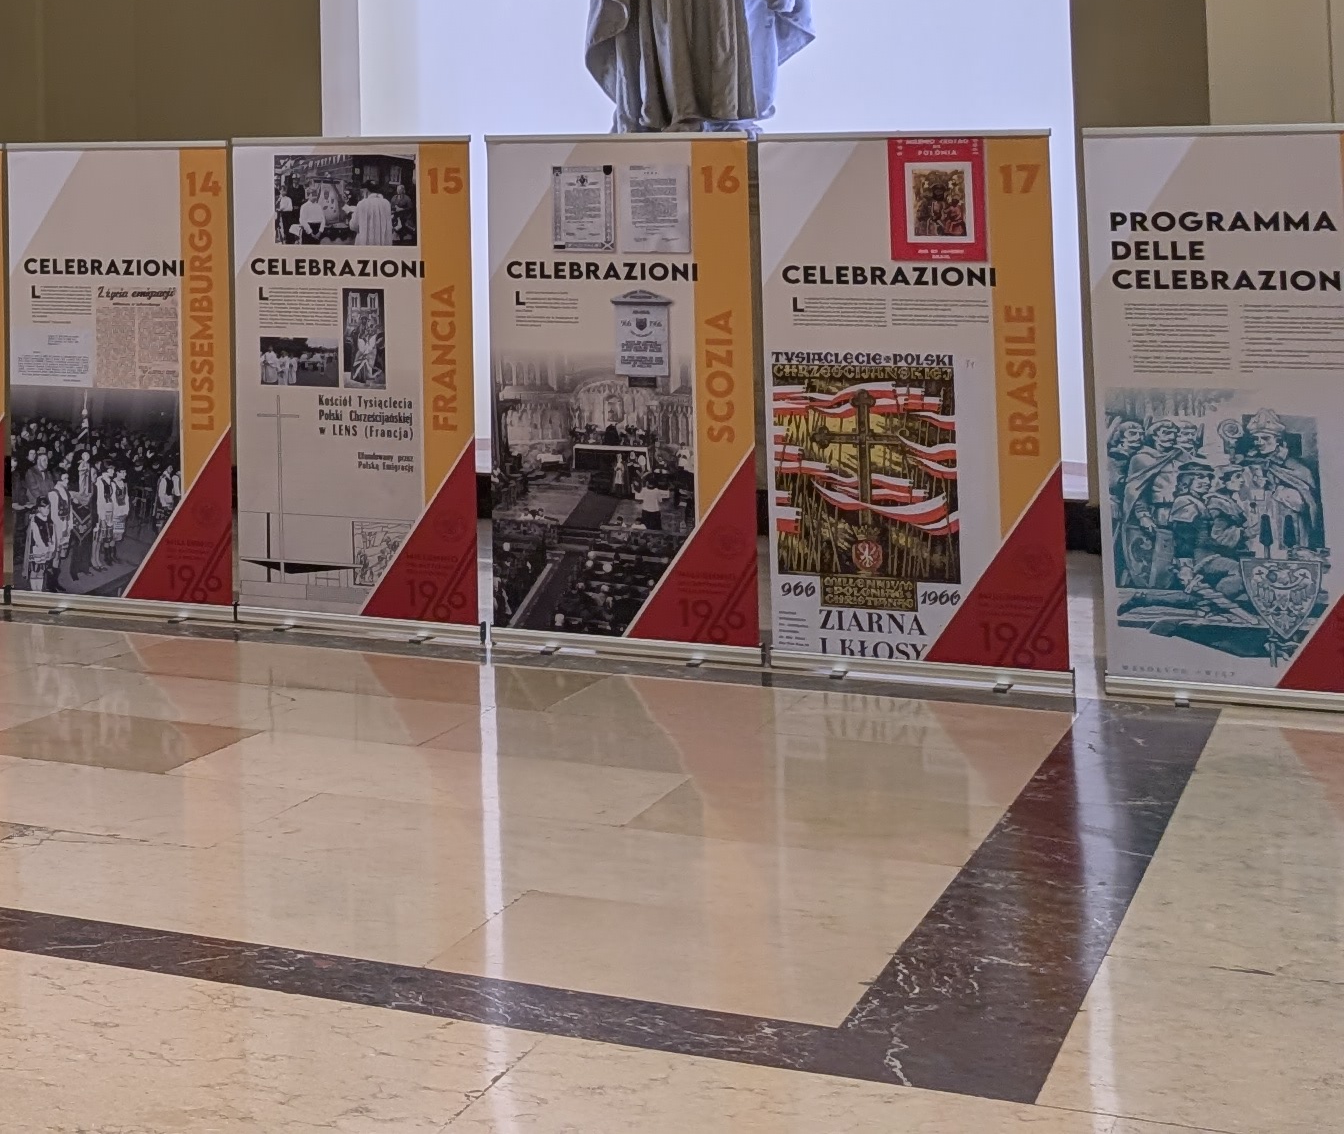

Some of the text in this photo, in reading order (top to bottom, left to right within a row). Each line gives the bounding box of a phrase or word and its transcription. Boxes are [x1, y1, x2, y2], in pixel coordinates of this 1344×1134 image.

[187, 171, 221, 197] 14
[428, 168, 462, 194] 15
[701, 166, 740, 194] 16
[1000, 164, 1039, 194] 17
[1110, 211, 1338, 231] PROGRAMMA
[1111, 241, 1205, 260] DELLE
[24, 258, 184, 277] CELEBRAZIONI
[251, 258, 425, 278] CELEBRAZIONI
[507, 261, 698, 281] CELEBRAZIONI
[782, 265, 997, 286] CELEBRAZIONI
[1112, 269, 1342, 291] CELEBRAZION
[32, 285, 41, 298] L
[259, 287, 269, 300] L
[515, 291, 526, 305] L
[792, 297, 805, 312] L
[188, 203, 214, 431] LUSSEMBURGO
[431, 285, 457, 431] FRANCIA
[892, 353, 954, 366] POLSKI
[704, 310, 735, 443] SCOZIA
[1004, 305, 1040, 457] BRASILE
[318, 395, 413, 409] Kościół Tysiąclecia
[319, 409, 343, 421] Polski
[319, 424, 413, 441] w LENS (Francja)
[781, 581, 816, 598] 966
[920, 589, 961, 606] 1966
[819, 609, 927, 636] ZIARNA
[839, 639, 927, 661] KŁOSY
